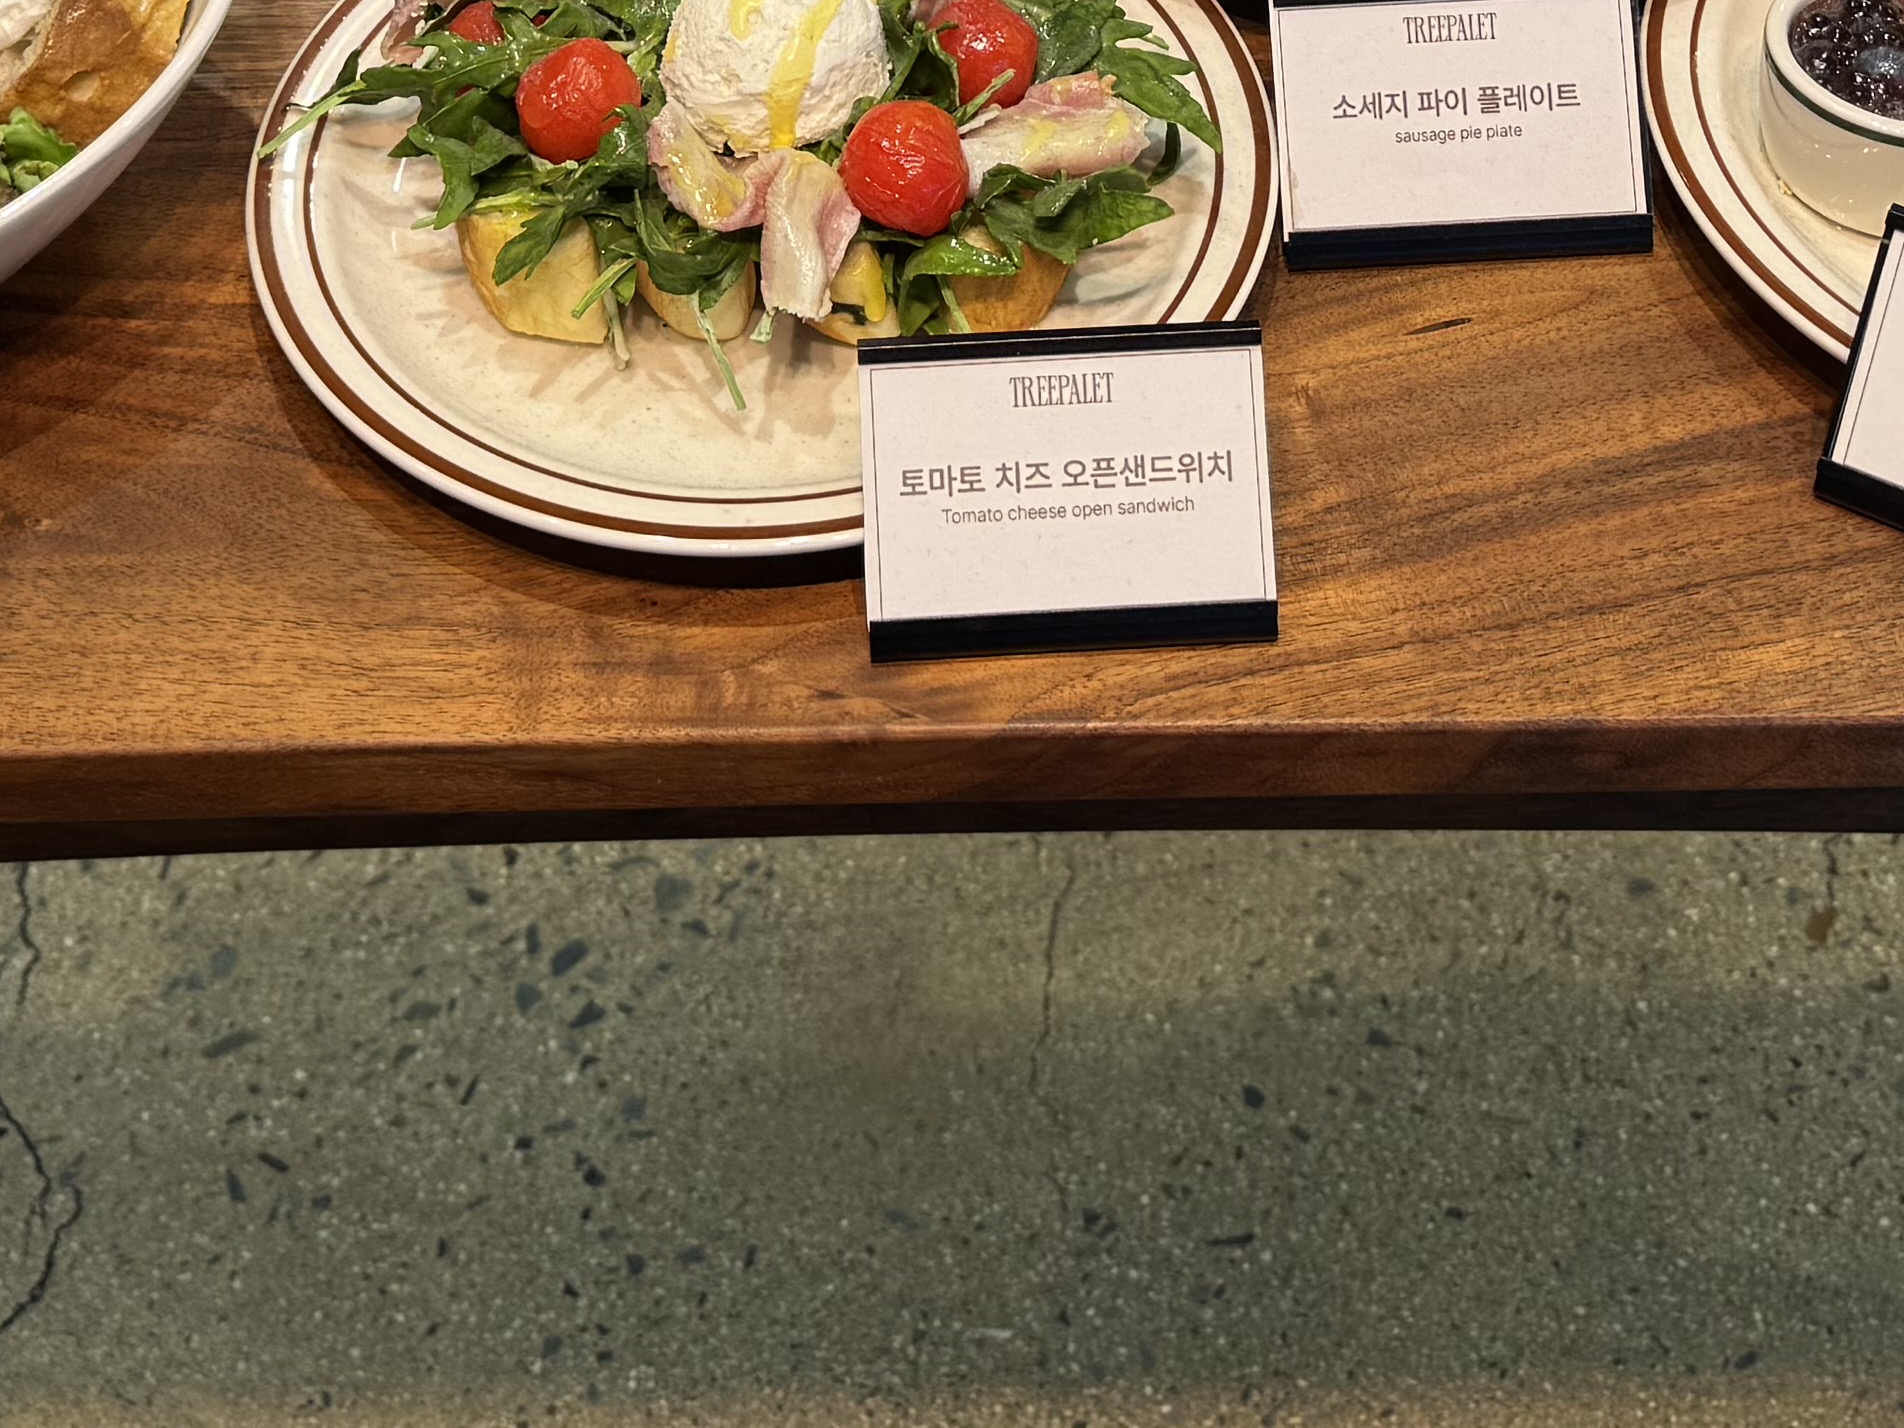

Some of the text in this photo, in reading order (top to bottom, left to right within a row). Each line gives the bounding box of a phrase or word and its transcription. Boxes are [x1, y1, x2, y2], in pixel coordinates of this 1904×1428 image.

[1403, 12, 1497, 44] TREEPALET
[1332, 82, 1581, 120] 소세지 파이 플레이트
[1395, 123, 1522, 144] sausage pie plate
[1009, 372, 1114, 408] TREEPALET
[899, 450, 1234, 498] 토마토 치즈 오픈샌드위치
[942, 496, 1195, 525] Tomato cheese open sandwich
